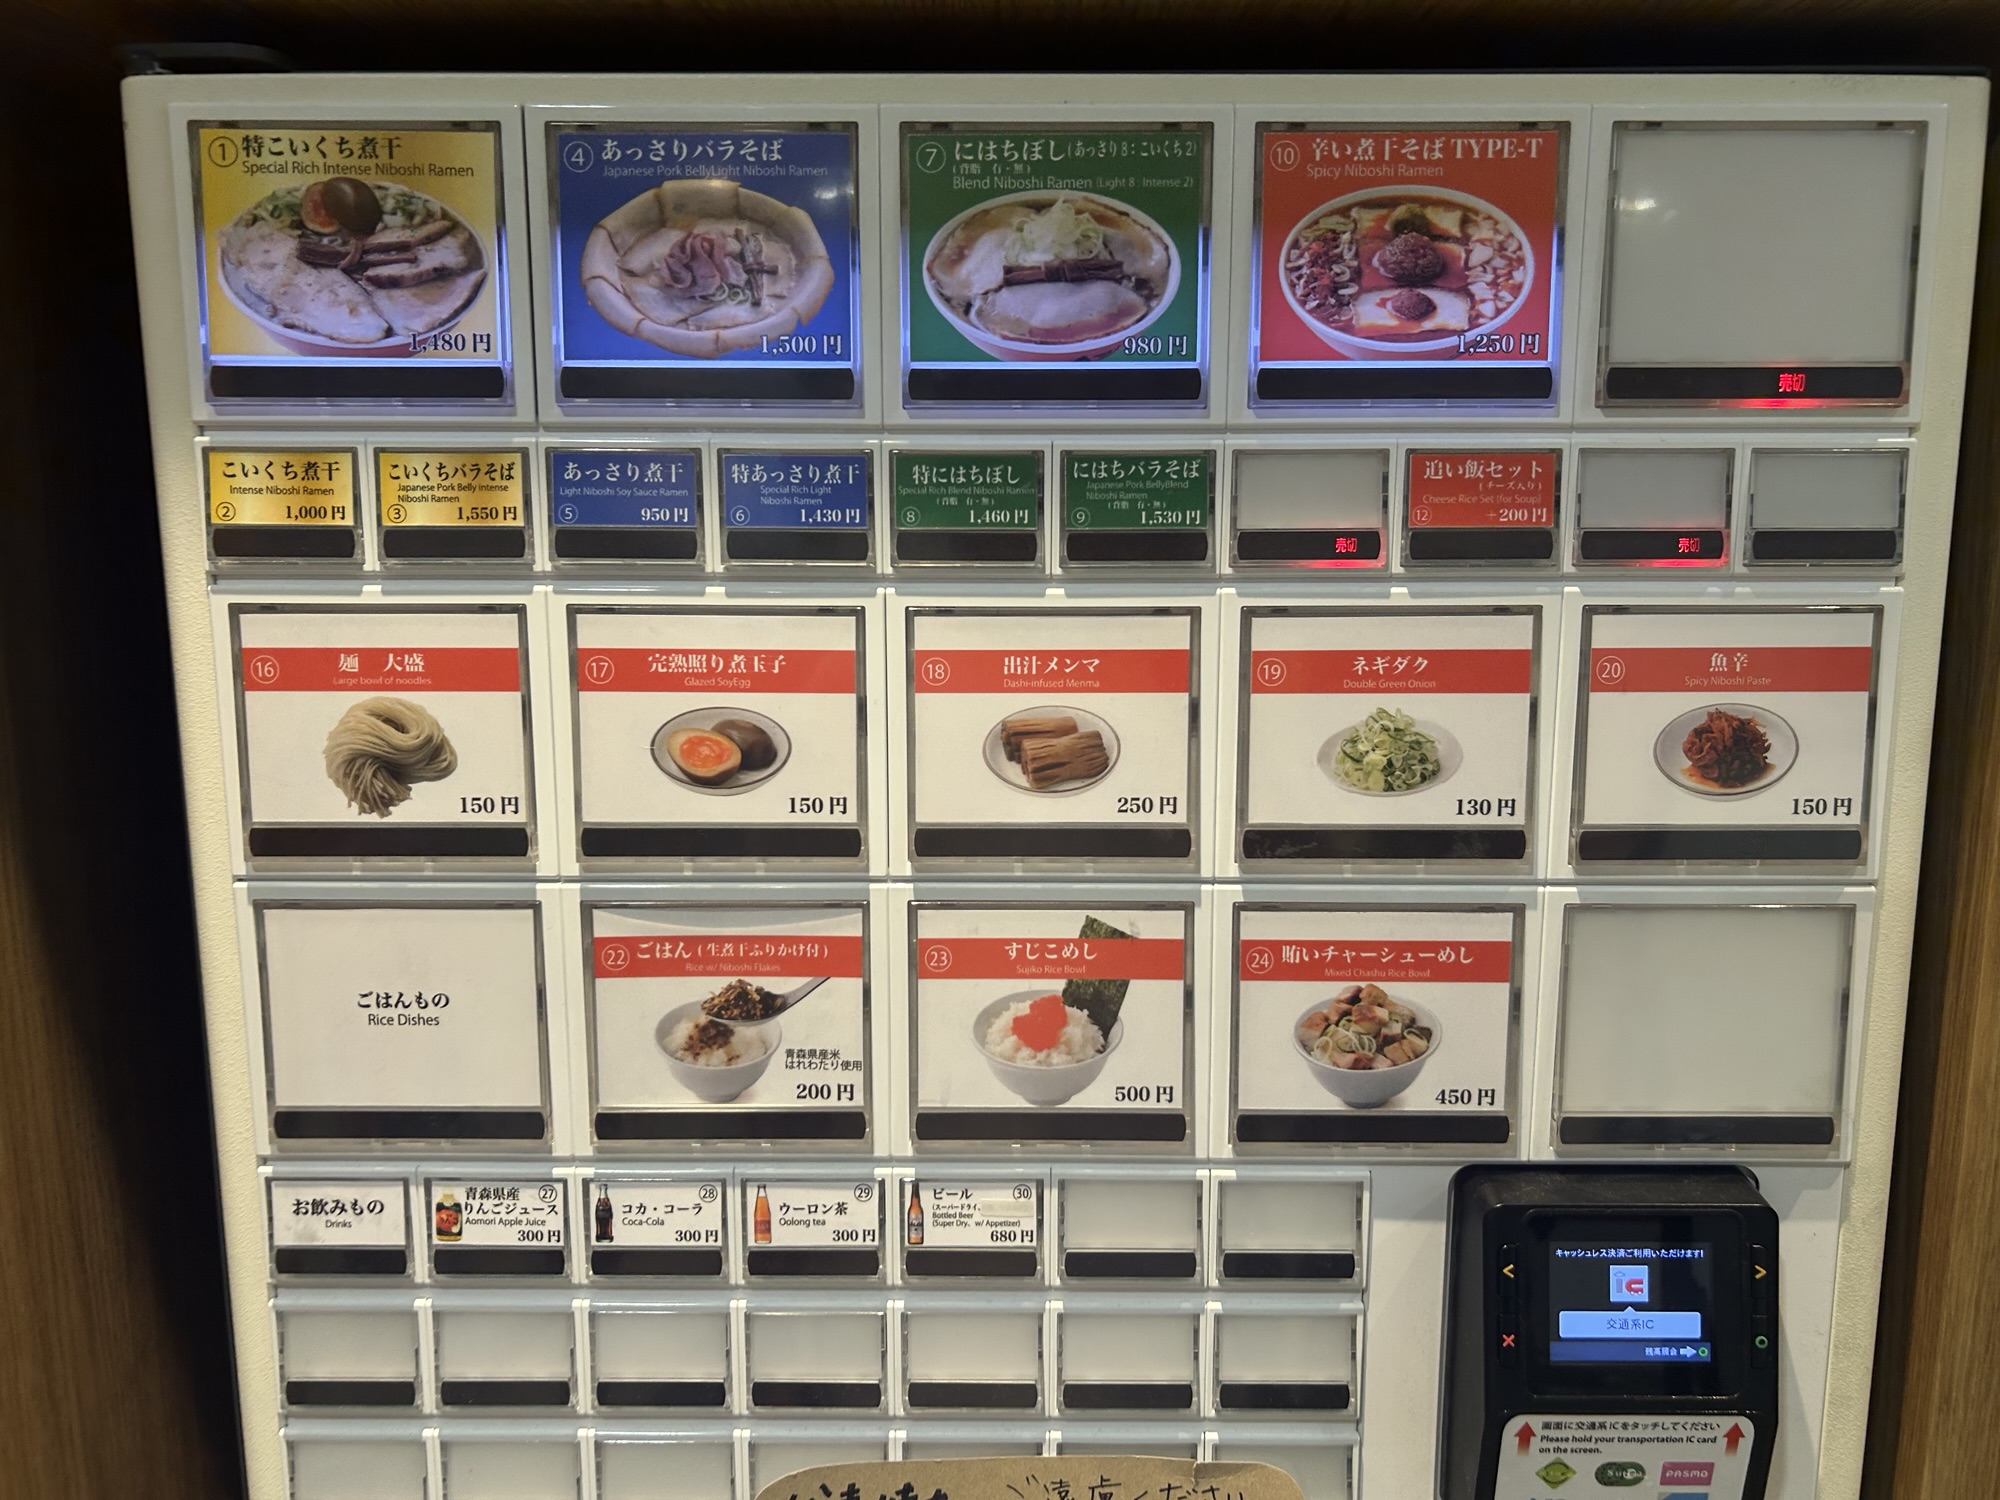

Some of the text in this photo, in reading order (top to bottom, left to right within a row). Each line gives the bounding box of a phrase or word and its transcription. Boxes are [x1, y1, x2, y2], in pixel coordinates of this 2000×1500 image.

[242, 135, 402, 159] 特こいくち煮干
[602, 140, 783, 161] あっさりバラそば
[1312, 138, 1543, 161] 辛い煮干そば TYPE-T
[242, 161, 474, 177] Special Rich Intense Niboshi Ramen
[603, 165, 654, 178] Japanese
[657, 166, 682, 176] Pork
[743, 165, 785, 176] Niboshi
[789, 166, 828, 176] Ramen
[1307, 164, 1443, 179] Spicy Niboshi Ramen
[953, 177, 1092, 189] Blend Niboshi Ramen
[1779, 373, 1805, 392] 売切
[223, 460, 340, 481] こいくち煮干
[389, 462, 515, 481] こいくちバラそば
[564, 462, 683, 482] あっさり煮干
[732, 464, 859, 484] 特あっさり煮干
[912, 464, 1020, 484] 特にはちぼし
[1073, 460, 1201, 479] にはちバラそば
[1424, 460, 1542, 479] 追い飯セット
[230, 485, 334, 495] Intense Niboshi Ramen
[398, 483, 435, 492] Japanese
[458, 484, 477, 493] Belly
[560, 488, 688, 497] Light Niboshi Soy Sauce Ramen
[760, 486, 831, 495] Special Rich Light
[794, 497, 822, 505] Ramen
[1335, 537, 1357, 553] 売切
[1678, 537, 1699, 553] 売切
[338, 653, 425, 672] 麺 大盛
[648, 654, 786, 674] 完熟照り煮玉子
[1004, 656, 1100, 675] 出汁メンマ
[1352, 656, 1428, 675] ネギダク
[1709, 652, 1748, 672] 魚辛
[333, 676, 432, 686] Large bowl of noodles
[684, 677, 715, 686] Glazed
[1004, 679, 1100, 688] Dashi-infused Menma
[1344, 680, 1436, 688] Double Green Onion
[1684, 676, 1771, 687] Spicy Niboshi Paste
[636, 941, 692, 959] ごはん
[1004, 942, 1097, 960] すじこめし
[1282, 945, 1474, 964] 賄いチャーシューめし
[686, 963, 781, 972] Rice w/ Niboshi Flakes
[1016, 965, 1085, 975] Sujiko Rice Bowl
[1325, 968, 1430, 978] Mixed Chashu Rice Bowl
[357, 990, 450, 1010] ごはんもの
[368, 1014, 440, 1026] Rice Dishes
[785, 1048, 840, 1060] 青森県産米
[785, 1060, 862, 1071] はれわたり使用
[465, 1187, 520, 1200] 青森県産
[933, 1188, 973, 1200] ビール
[292, 1199, 384, 1216] お飲みもの
[465, 1202, 558, 1215] りんごジュース
[622, 1203, 702, 1215] コカ・コーラ
[779, 1202, 848, 1216] ウーロン茶
[325, 1219, 352, 1228] Drinks
[465, 1217, 546, 1227] Aomori Apple Juice
[622, 1217, 664, 1226] Coca-Cola
[779, 1218, 826, 1227] Oolong tea
[1607, 1318, 1654, 1330] 交通系IC
[1617, 1436, 1683, 1444] transportation
